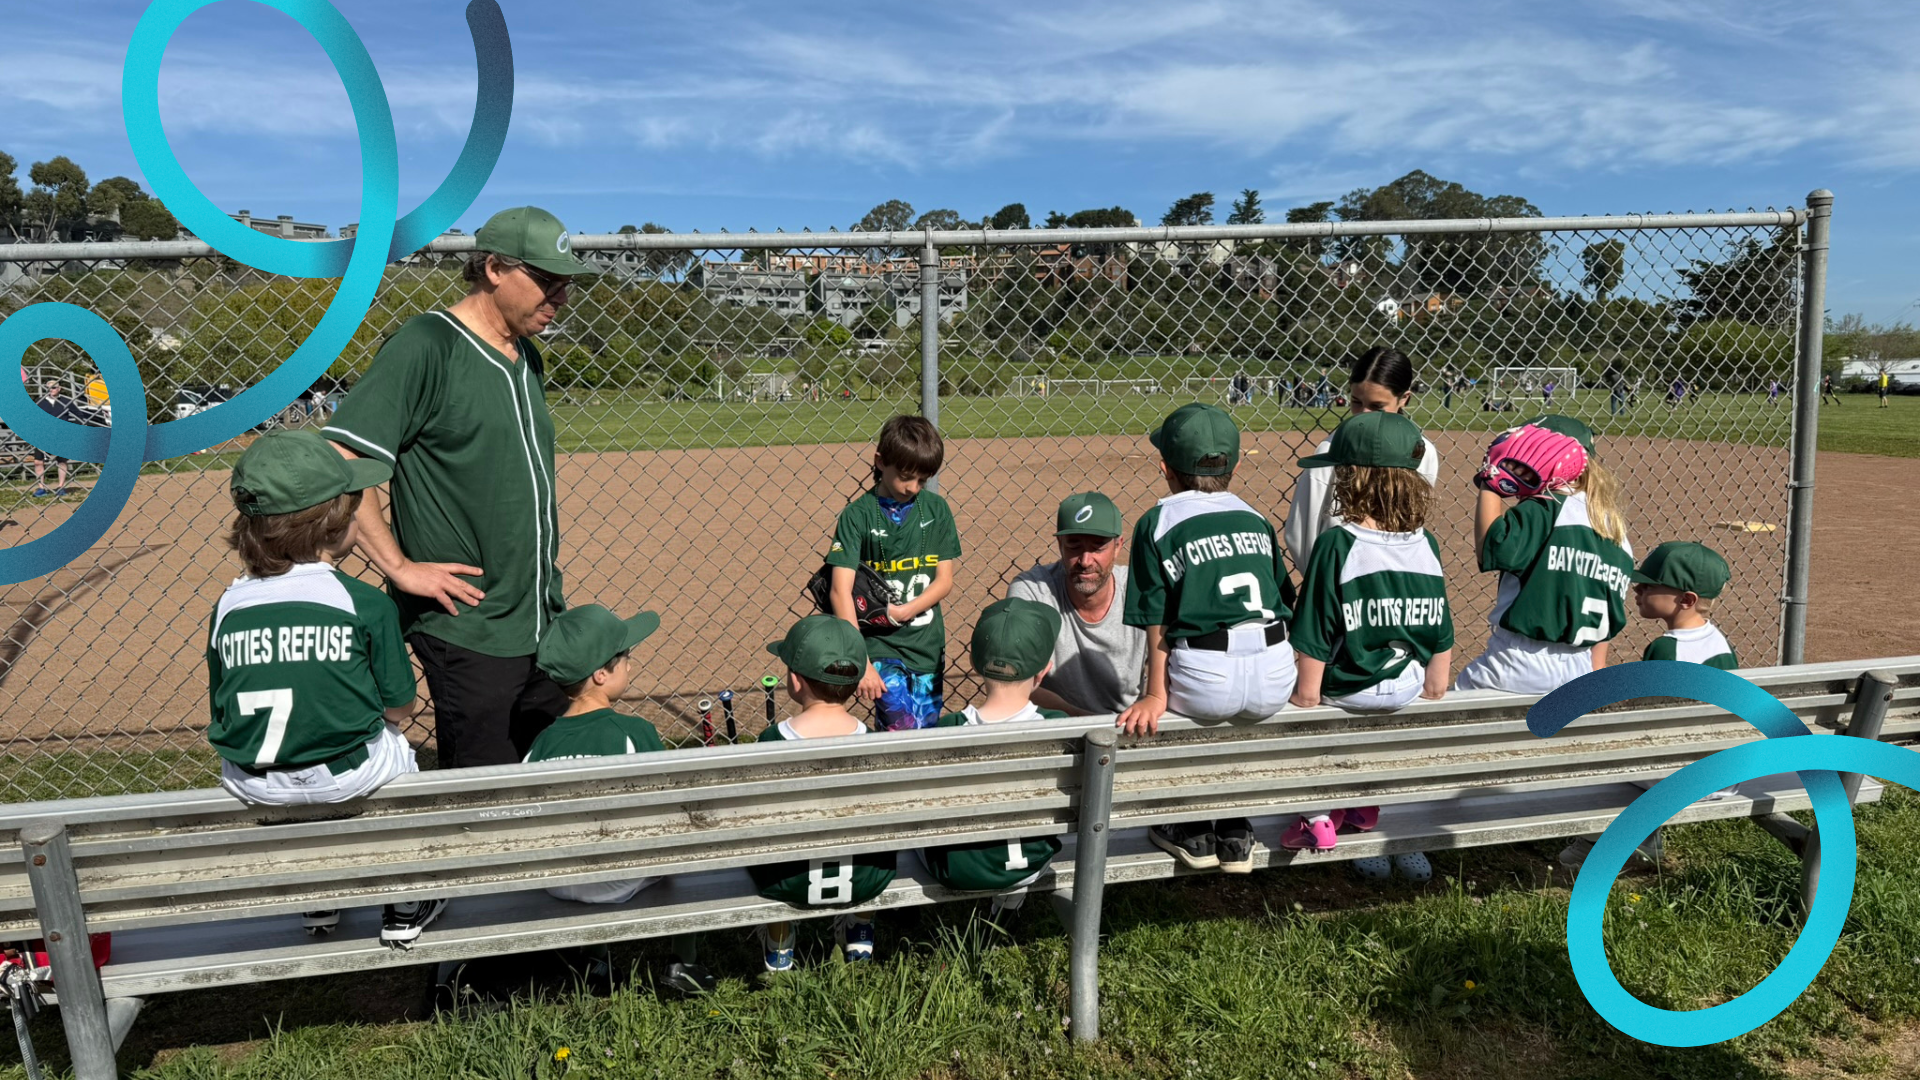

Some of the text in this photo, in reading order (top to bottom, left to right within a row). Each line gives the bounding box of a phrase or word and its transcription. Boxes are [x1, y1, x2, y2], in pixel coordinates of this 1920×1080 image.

[1162, 547, 1186, 582] BAY
[1186, 533, 1235, 566] CITIES
[1547, 545, 1575, 573] BAY
[1342, 597, 1445, 632] BY CITS REFUS
[222, 627, 273, 670] CITIES
[278, 625, 353, 663] REFUSE
[237, 688, 293, 769] 7
[808, 856, 853, 905] 8
